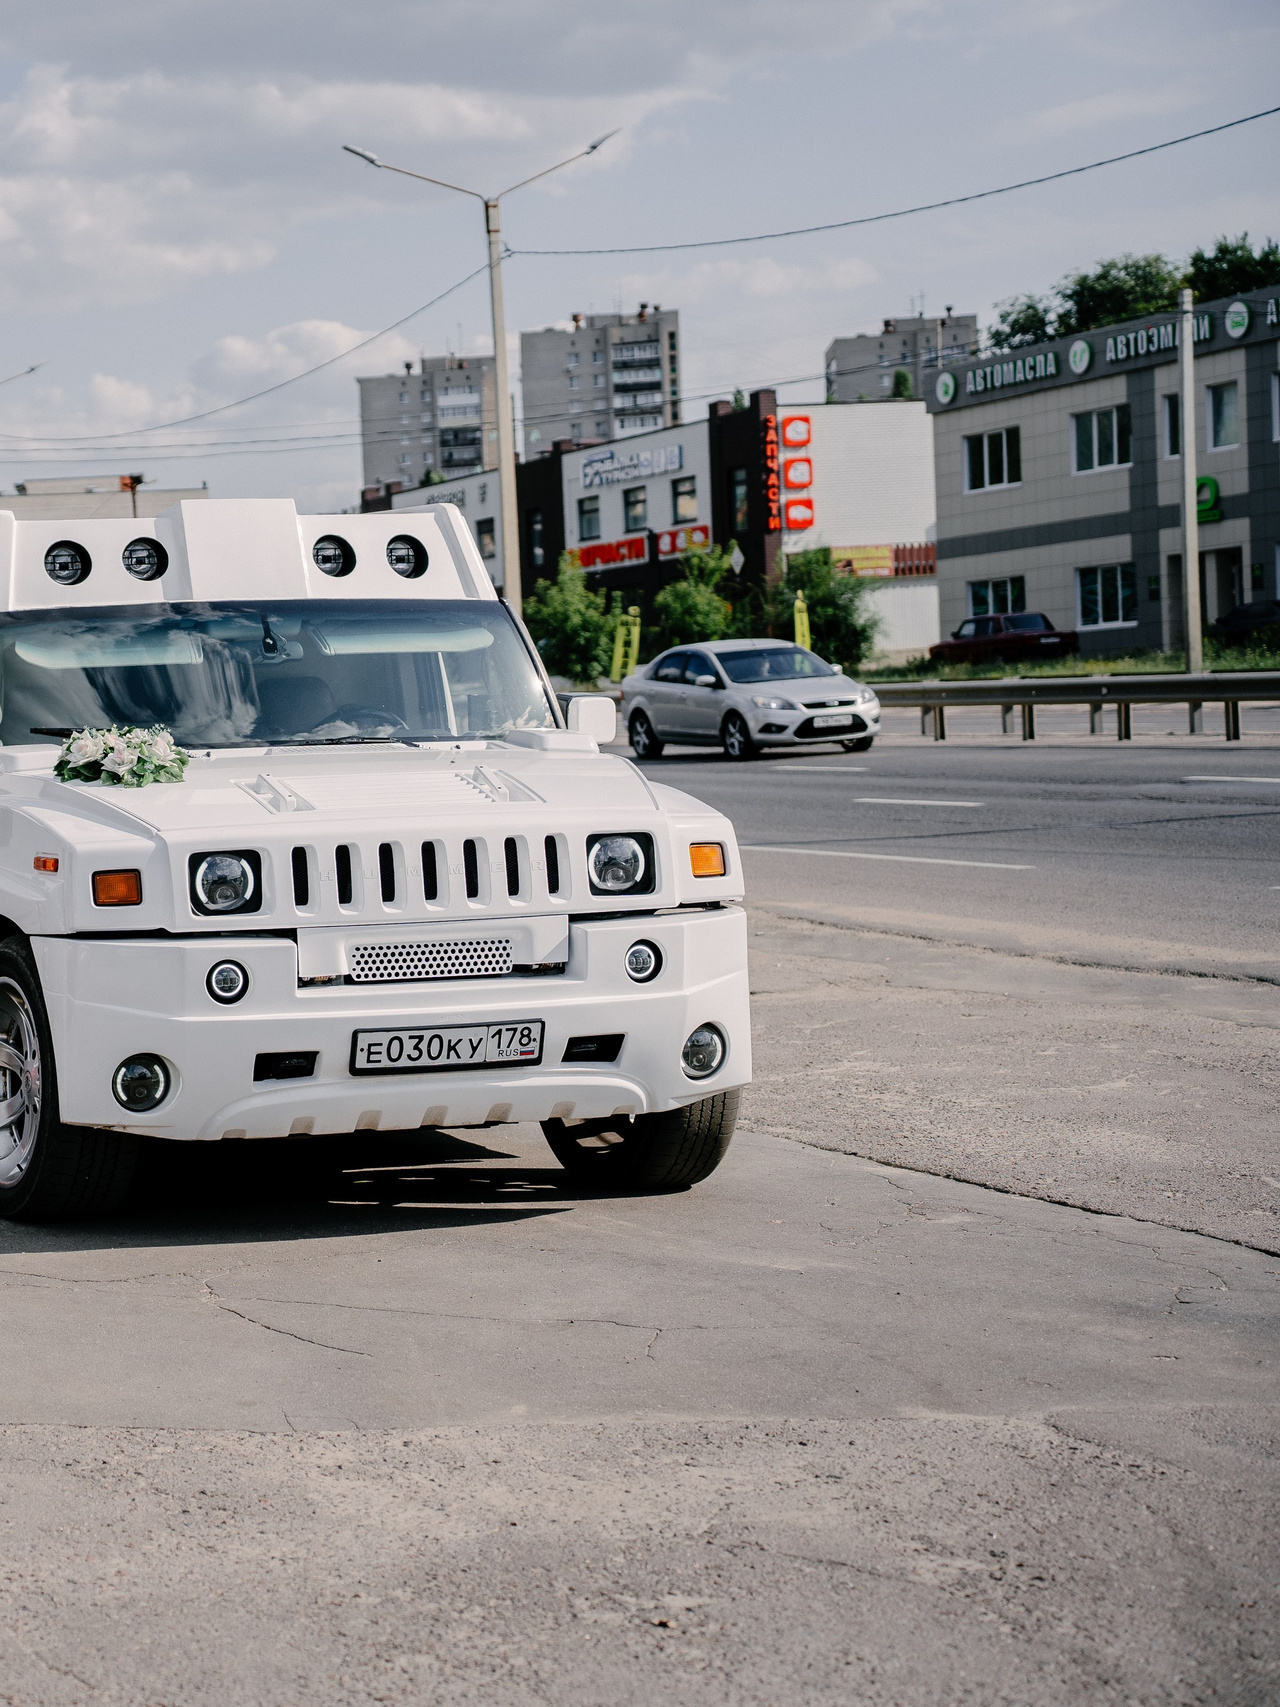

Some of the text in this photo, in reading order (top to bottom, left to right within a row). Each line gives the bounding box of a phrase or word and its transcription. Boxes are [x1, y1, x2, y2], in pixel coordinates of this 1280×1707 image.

[966, 351, 1058, 393] АВТОМАСЛА
[1266, 297, 1280, 325] А
[766, 414, 780, 530] ЗАПЧАСТИ
[490, 1026, 533, 1050] 178
[497, 1048, 520, 1058] RUS
